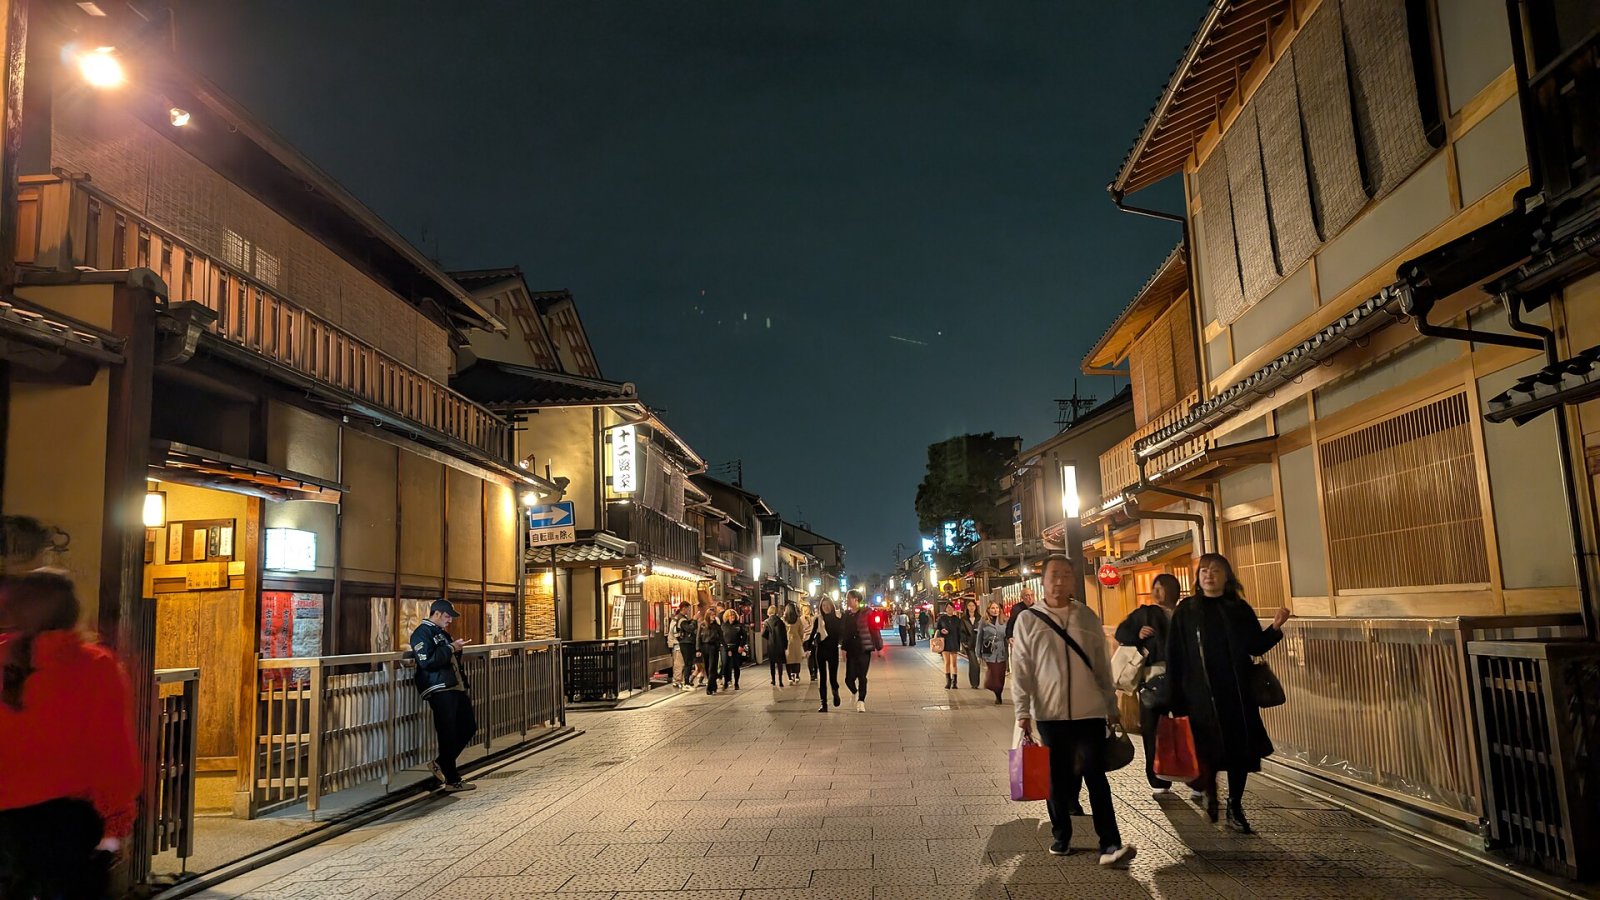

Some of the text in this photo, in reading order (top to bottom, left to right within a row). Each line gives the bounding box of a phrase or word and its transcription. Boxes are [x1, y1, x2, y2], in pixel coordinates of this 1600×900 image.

[532, 530, 573, 542] 自転車を除く
